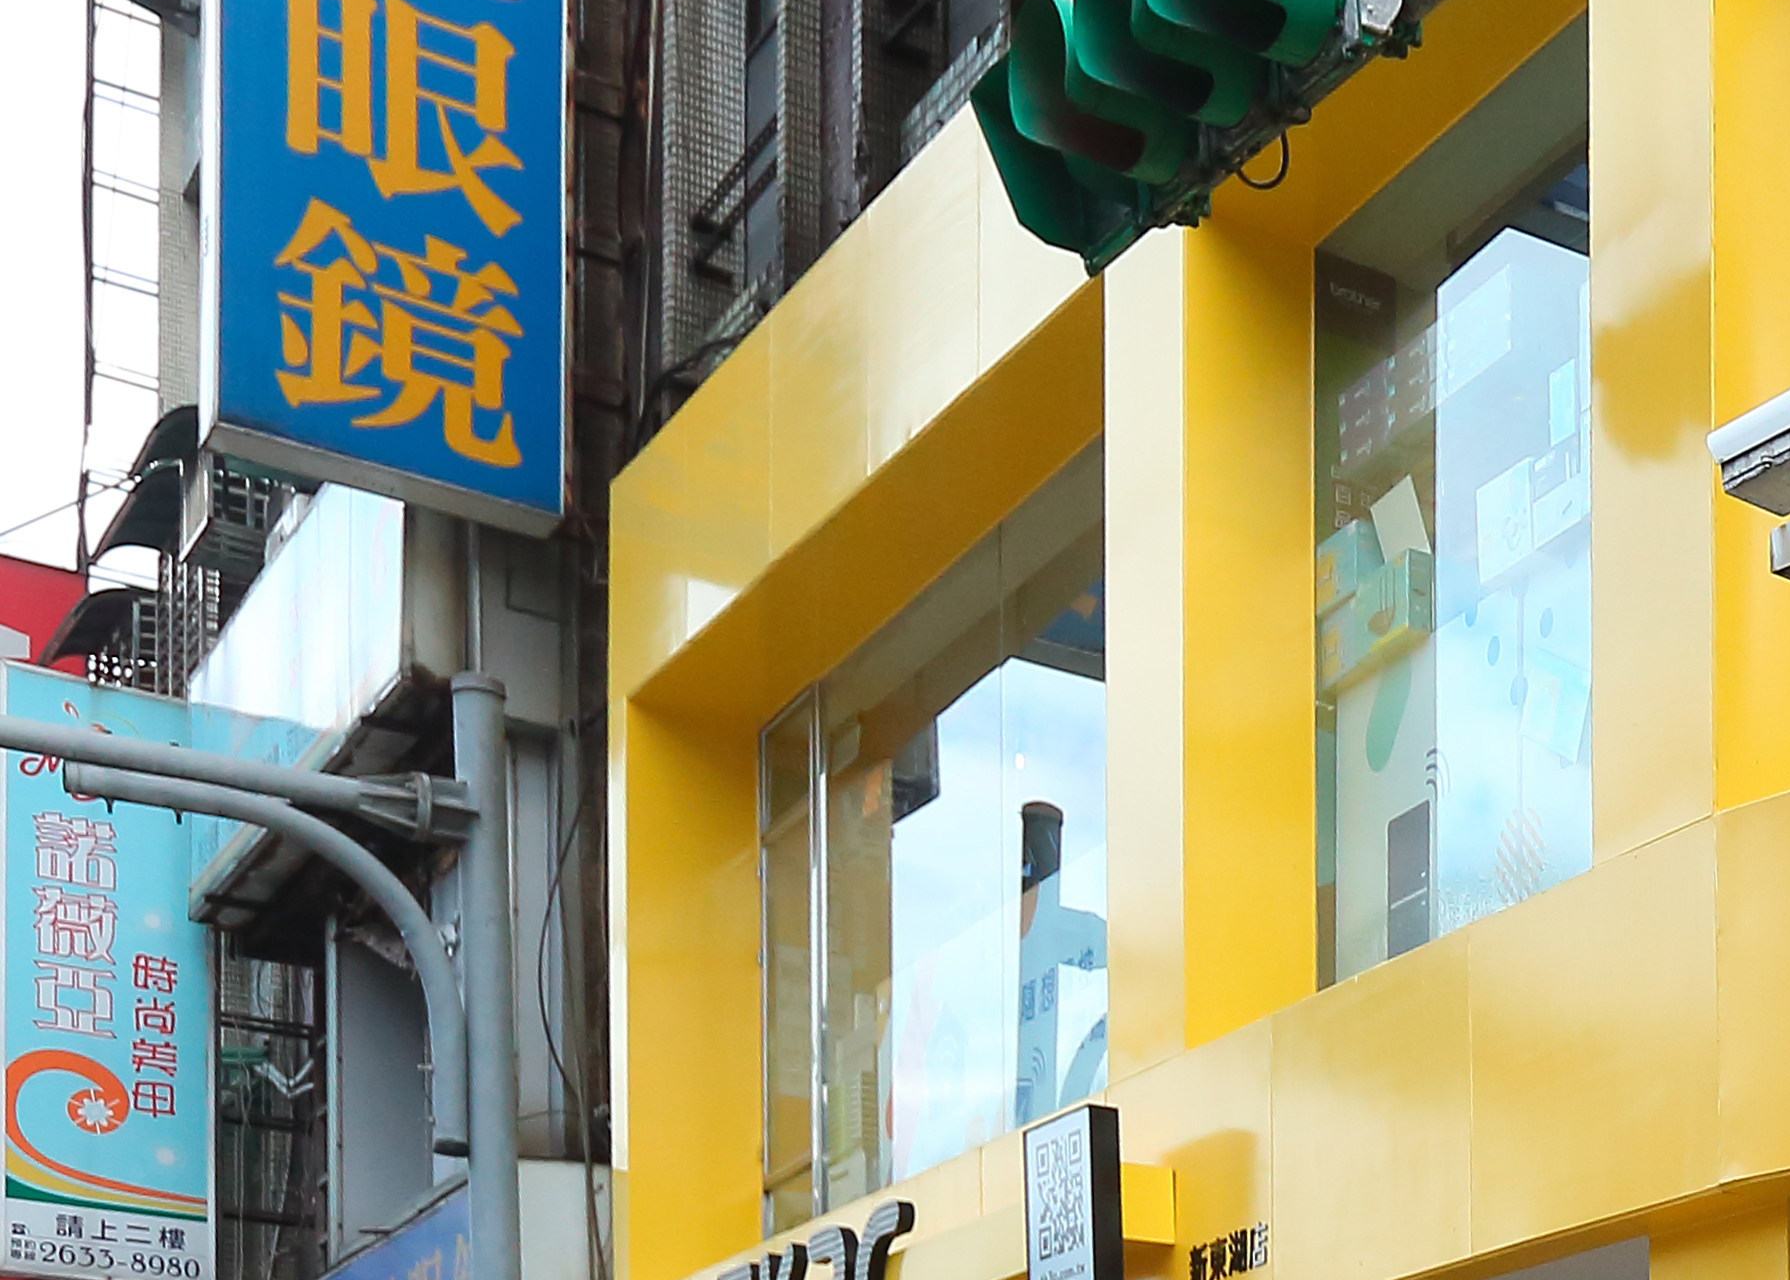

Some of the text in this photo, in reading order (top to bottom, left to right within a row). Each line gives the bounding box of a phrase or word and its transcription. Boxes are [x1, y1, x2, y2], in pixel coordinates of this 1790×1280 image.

[32, 810, 119, 1041] 諾薇亞
[55, 1213, 187, 1252] 請上二樓
[39, 1241, 201, 1280] 2633-8980
